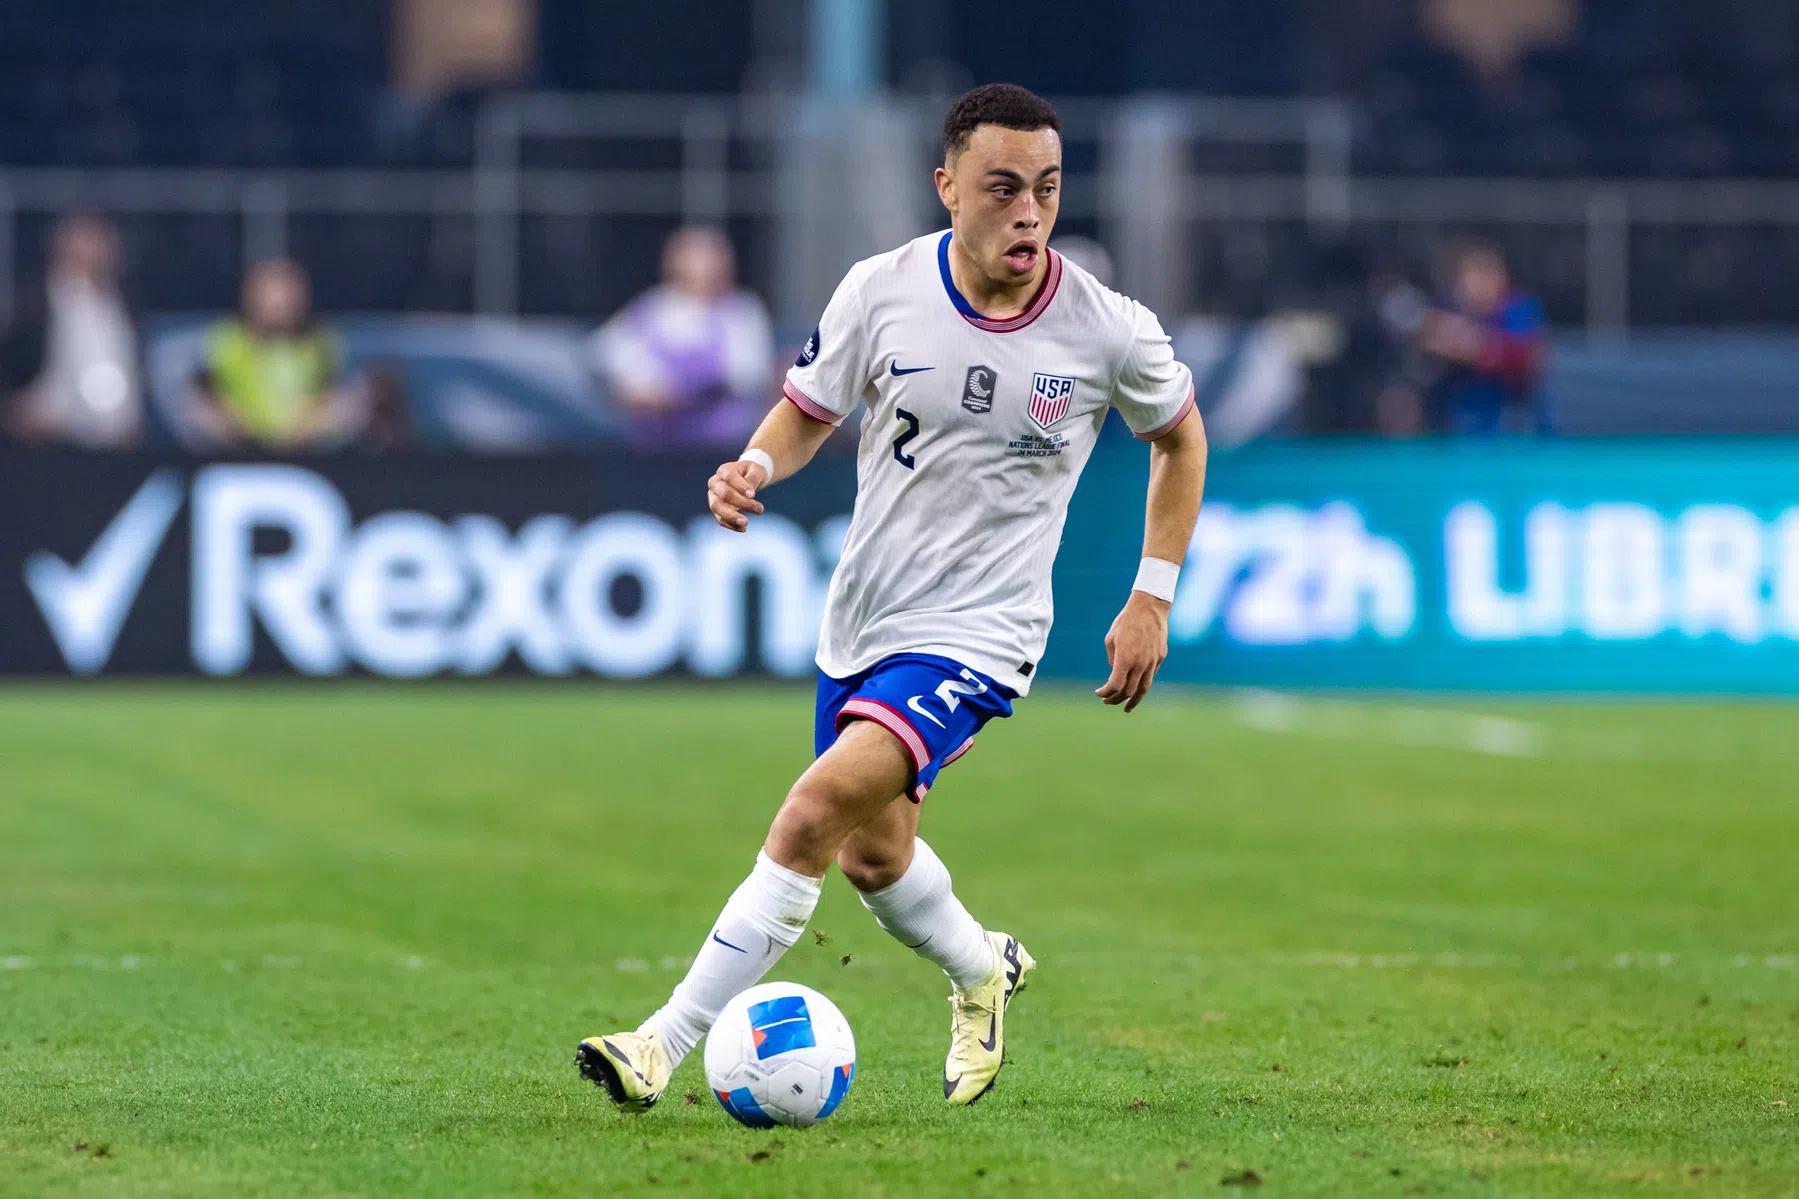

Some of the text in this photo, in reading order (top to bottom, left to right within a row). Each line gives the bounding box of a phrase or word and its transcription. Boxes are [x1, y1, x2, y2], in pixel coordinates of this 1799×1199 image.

[1036, 377, 1071, 399] USA
[893, 407, 920, 470] 2
[1008, 439, 1070, 450] NATIONS LEAGUE FINAL
[1045, 433, 1062, 442] MEXICO
[1446, 502, 1799, 644] LIBR
[935, 667, 988, 714] 2
